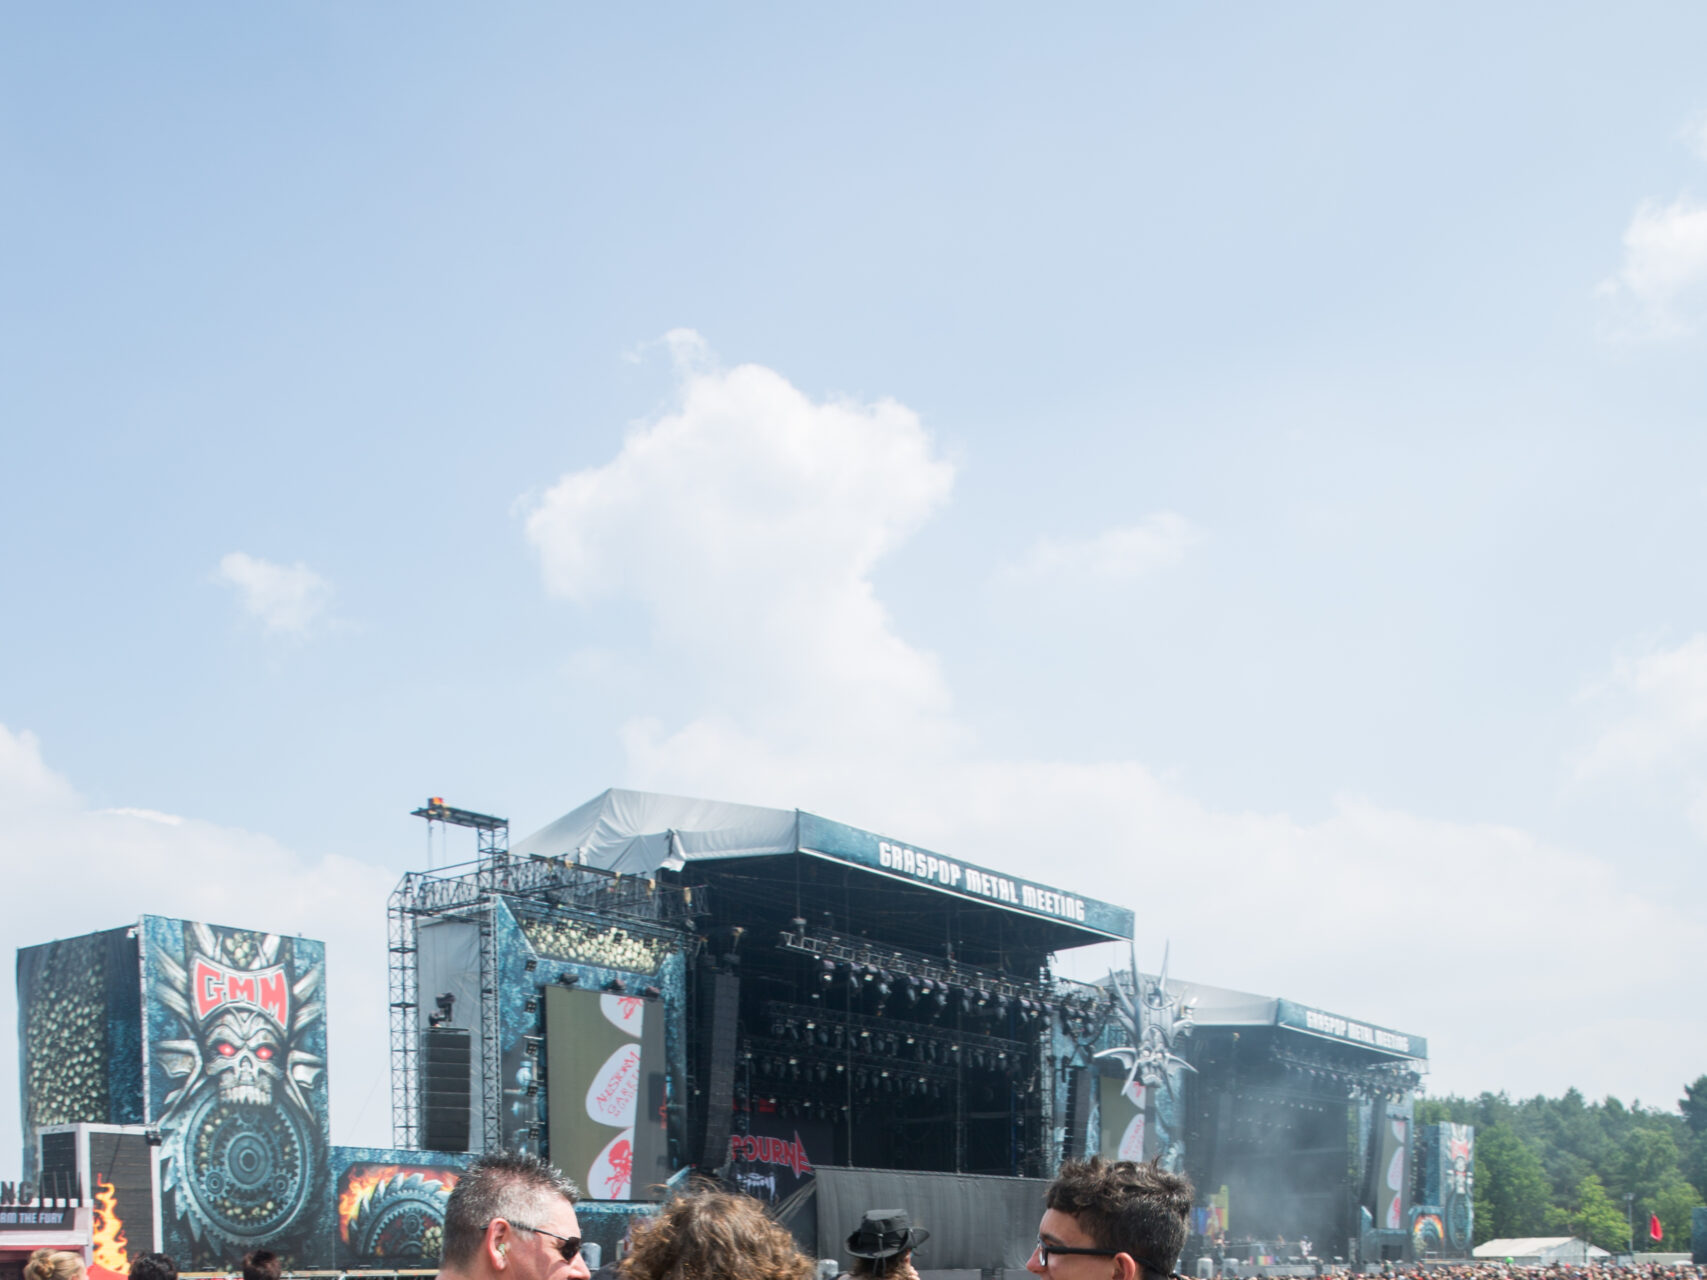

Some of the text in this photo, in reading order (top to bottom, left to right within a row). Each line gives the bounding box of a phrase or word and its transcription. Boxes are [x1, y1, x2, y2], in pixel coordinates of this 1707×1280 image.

[878, 842, 1085, 922] GRASPOP METAL MEETING
[195, 958, 288, 1030] GMM
[19, 1212, 37, 1224] THE
[39, 1212, 64, 1224] FURY
